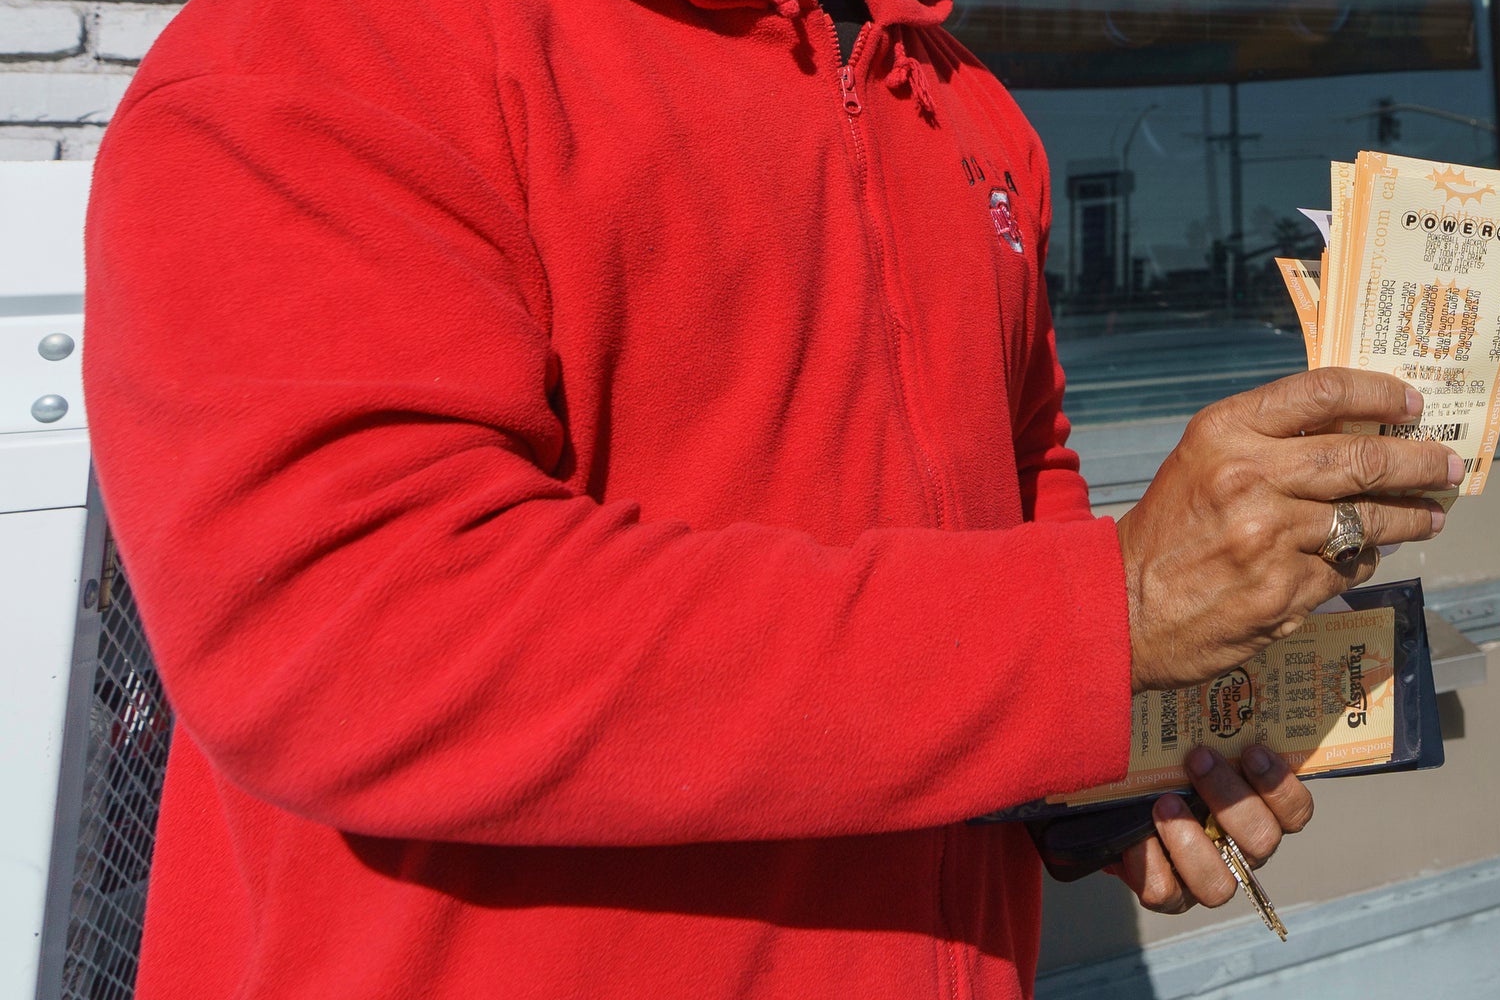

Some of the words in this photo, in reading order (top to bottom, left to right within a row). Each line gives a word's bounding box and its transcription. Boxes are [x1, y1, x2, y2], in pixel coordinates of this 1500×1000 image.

[1427, 233, 1458, 243] POWERBALL
[1464, 239, 1487, 248] JACKPOT
[1433, 262, 1451, 272] QUICK
[1454, 265, 1469, 274] PICK
[1439, 256, 1453, 265] YOUR
[1365, 210, 1391, 329] calottery.com
[1380, 286, 1394, 295] 25
[1401, 289, 1415, 297] 26
[1422, 291, 1436, 300] 30
[1381, 279, 1396, 287] 07
[1402, 281, 1417, 290] 24
[1424, 284, 1438, 292] 36
[1445, 286, 1459, 295] 42
[1466, 289, 1480, 297] 52
[1378, 301, 1392, 309] 02
[1399, 303, 1413, 312] 10
[1420, 306, 1434, 314] 33
[1462, 311, 1476, 319] 63
[1379, 294, 1393, 302] 01
[1400, 296, 1414, 304] 10
[1421, 298, 1435, 307] 26
[1443, 301, 1457, 309] 43
[1376, 316, 1390, 324] 14
[1396, 318, 1411, 326] 17
[1417, 320, 1431, 329] 23
[1439, 323, 1453, 331] 31
[1459, 325, 1474, 333] 39
[1377, 308, 1391, 317] 30
[1398, 311, 1412, 319] 32
[1418, 313, 1432, 321] 59
[1440, 315, 1454, 324] 60
[1374, 331, 1388, 339] 11
[1394, 333, 1408, 341] 29
[1414, 335, 1429, 343] 35
[1436, 337, 1450, 346] 38
[1457, 339, 1471, 348] 39
[1375, 323, 1389, 332] 04
[1395, 325, 1409, 334] 32
[1416, 328, 1430, 336] 57
[1437, 330, 1451, 338] 64
[1458, 332, 1472, 340] 67
[1372, 346, 1386, 354] 23
[1392, 348, 1406, 356] 52
[1412, 349, 1426, 358] 62
[1433, 351, 1448, 360] 67
[1487, 354, 1500, 362] 11
[1373, 338, 1387, 347] 02
[1393, 340, 1407, 348] 04
[1413, 342, 1427, 350] 16
[1435, 344, 1449, 353] 28
[1484, 421, 1500, 454] play
[1348, 643, 1366, 711] Fantasy
[1230, 676, 1245, 703] 2ND
[1222, 686, 1232, 731] CHANCE
[1346, 709, 1367, 729] 5
[1325, 743, 1347, 761] play
